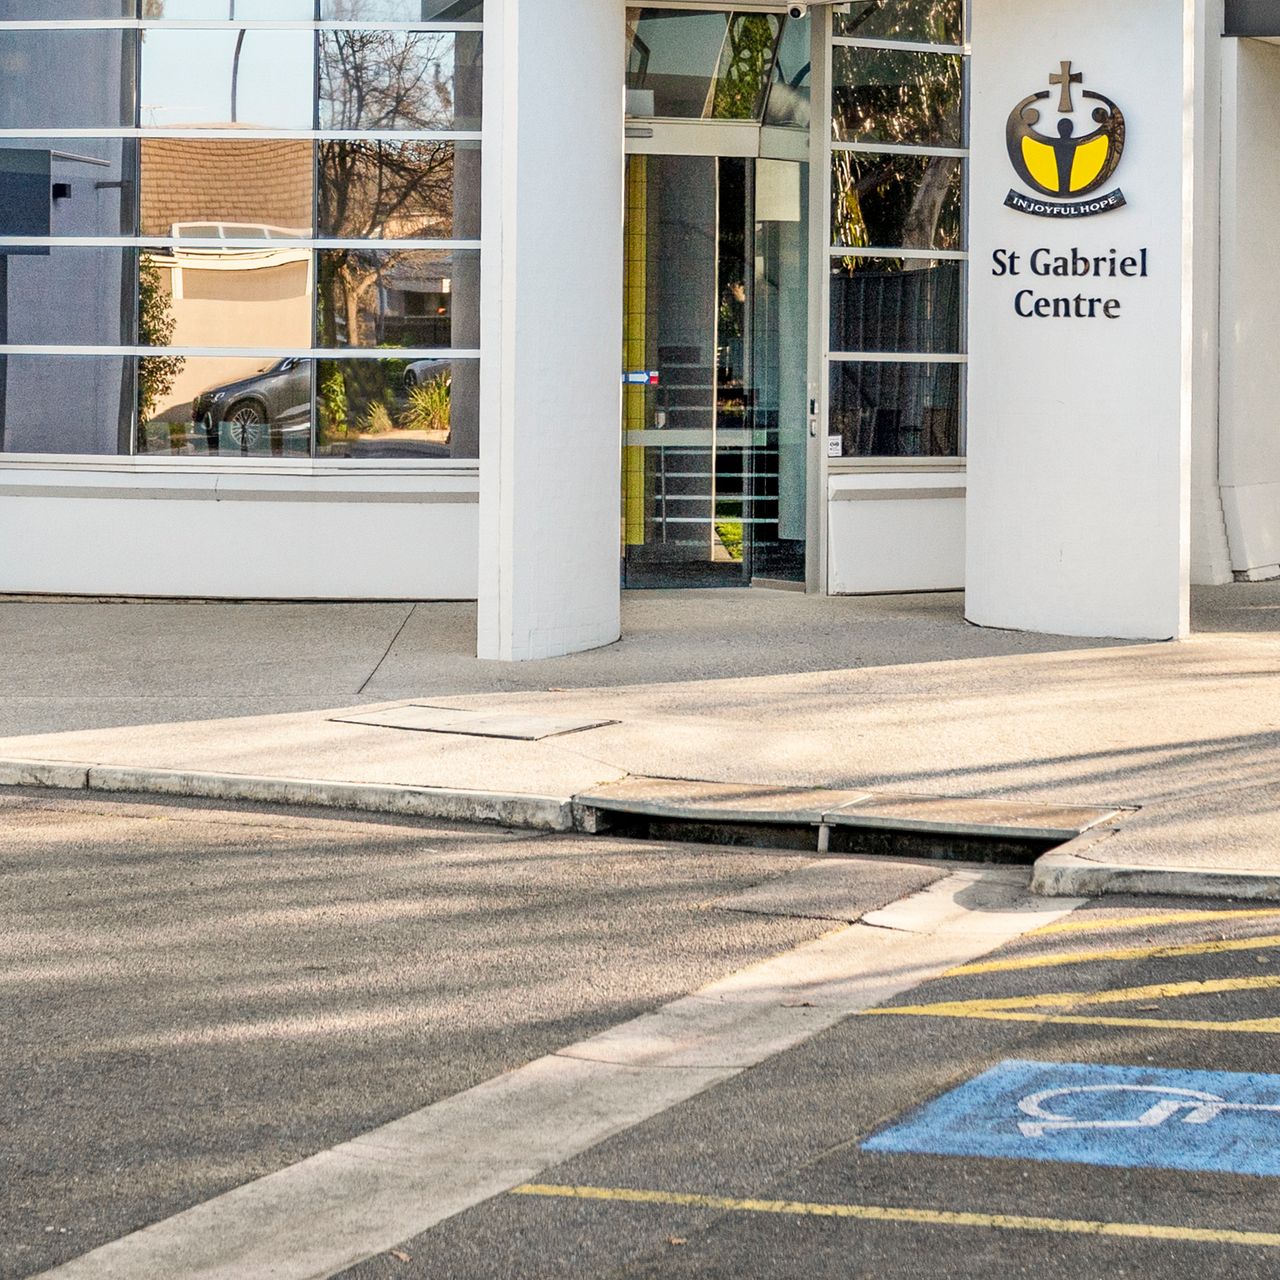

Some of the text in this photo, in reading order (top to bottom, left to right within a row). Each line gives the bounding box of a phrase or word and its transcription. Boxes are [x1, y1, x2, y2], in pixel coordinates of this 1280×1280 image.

[1013, 196, 1117, 215] IN JOYFUL HOPE
[991, 247, 1149, 277] St Gabriel
[1014, 289, 1121, 319] Centre
